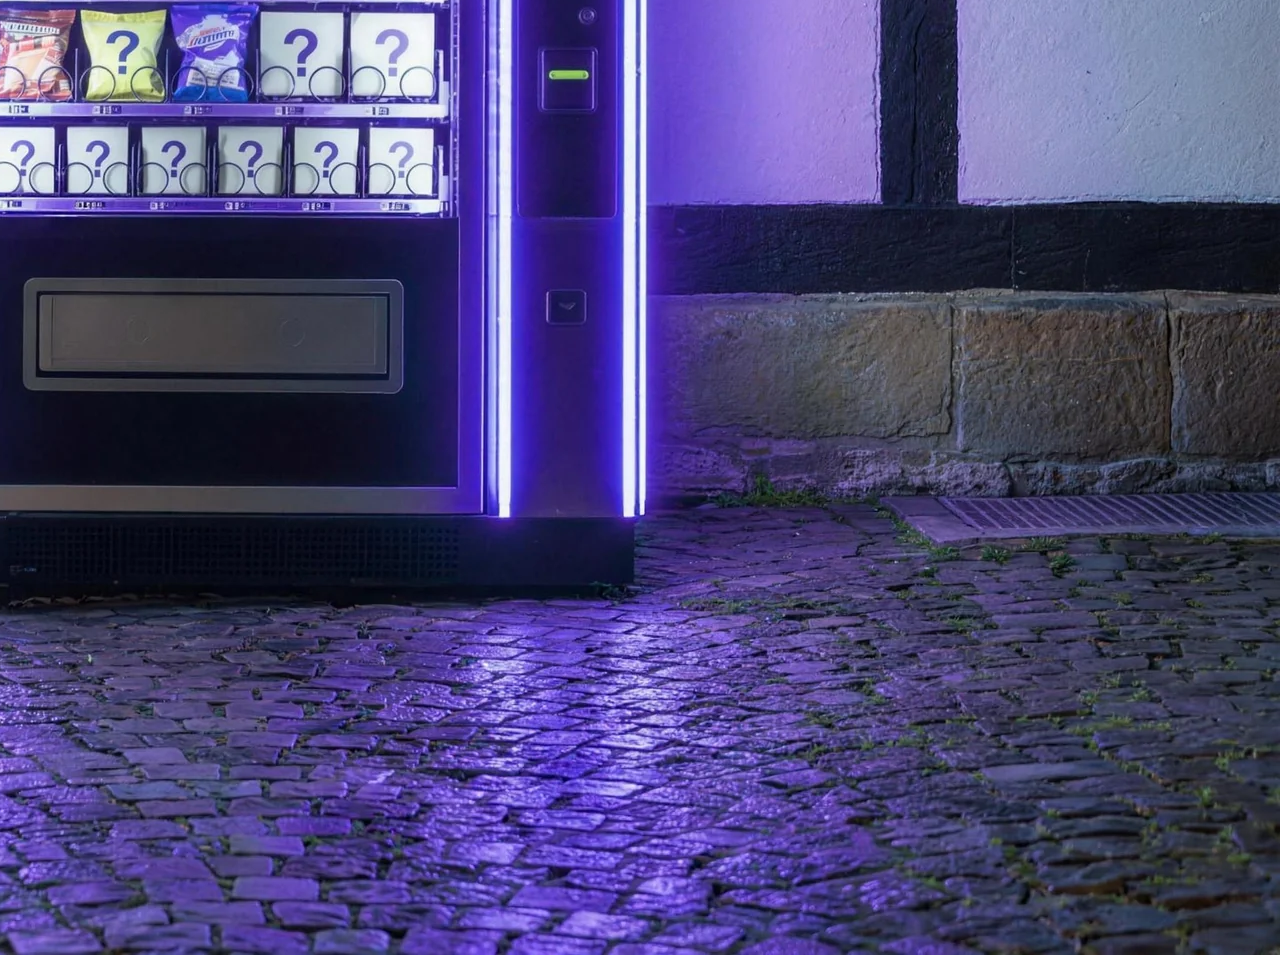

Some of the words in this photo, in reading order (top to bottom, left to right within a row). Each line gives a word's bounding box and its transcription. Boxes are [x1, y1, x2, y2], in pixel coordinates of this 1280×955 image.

[106, 29, 140, 75] ?
[284, 28, 319, 77] ?
[375, 29, 409, 77] ?
[10, 139, 36, 177] ?
[85, 139, 111, 178] ?
[161, 139, 187, 178] ?
[238, 140, 264, 178] ?
[314, 140, 339, 178] ?
[389, 140, 415, 179] ?
